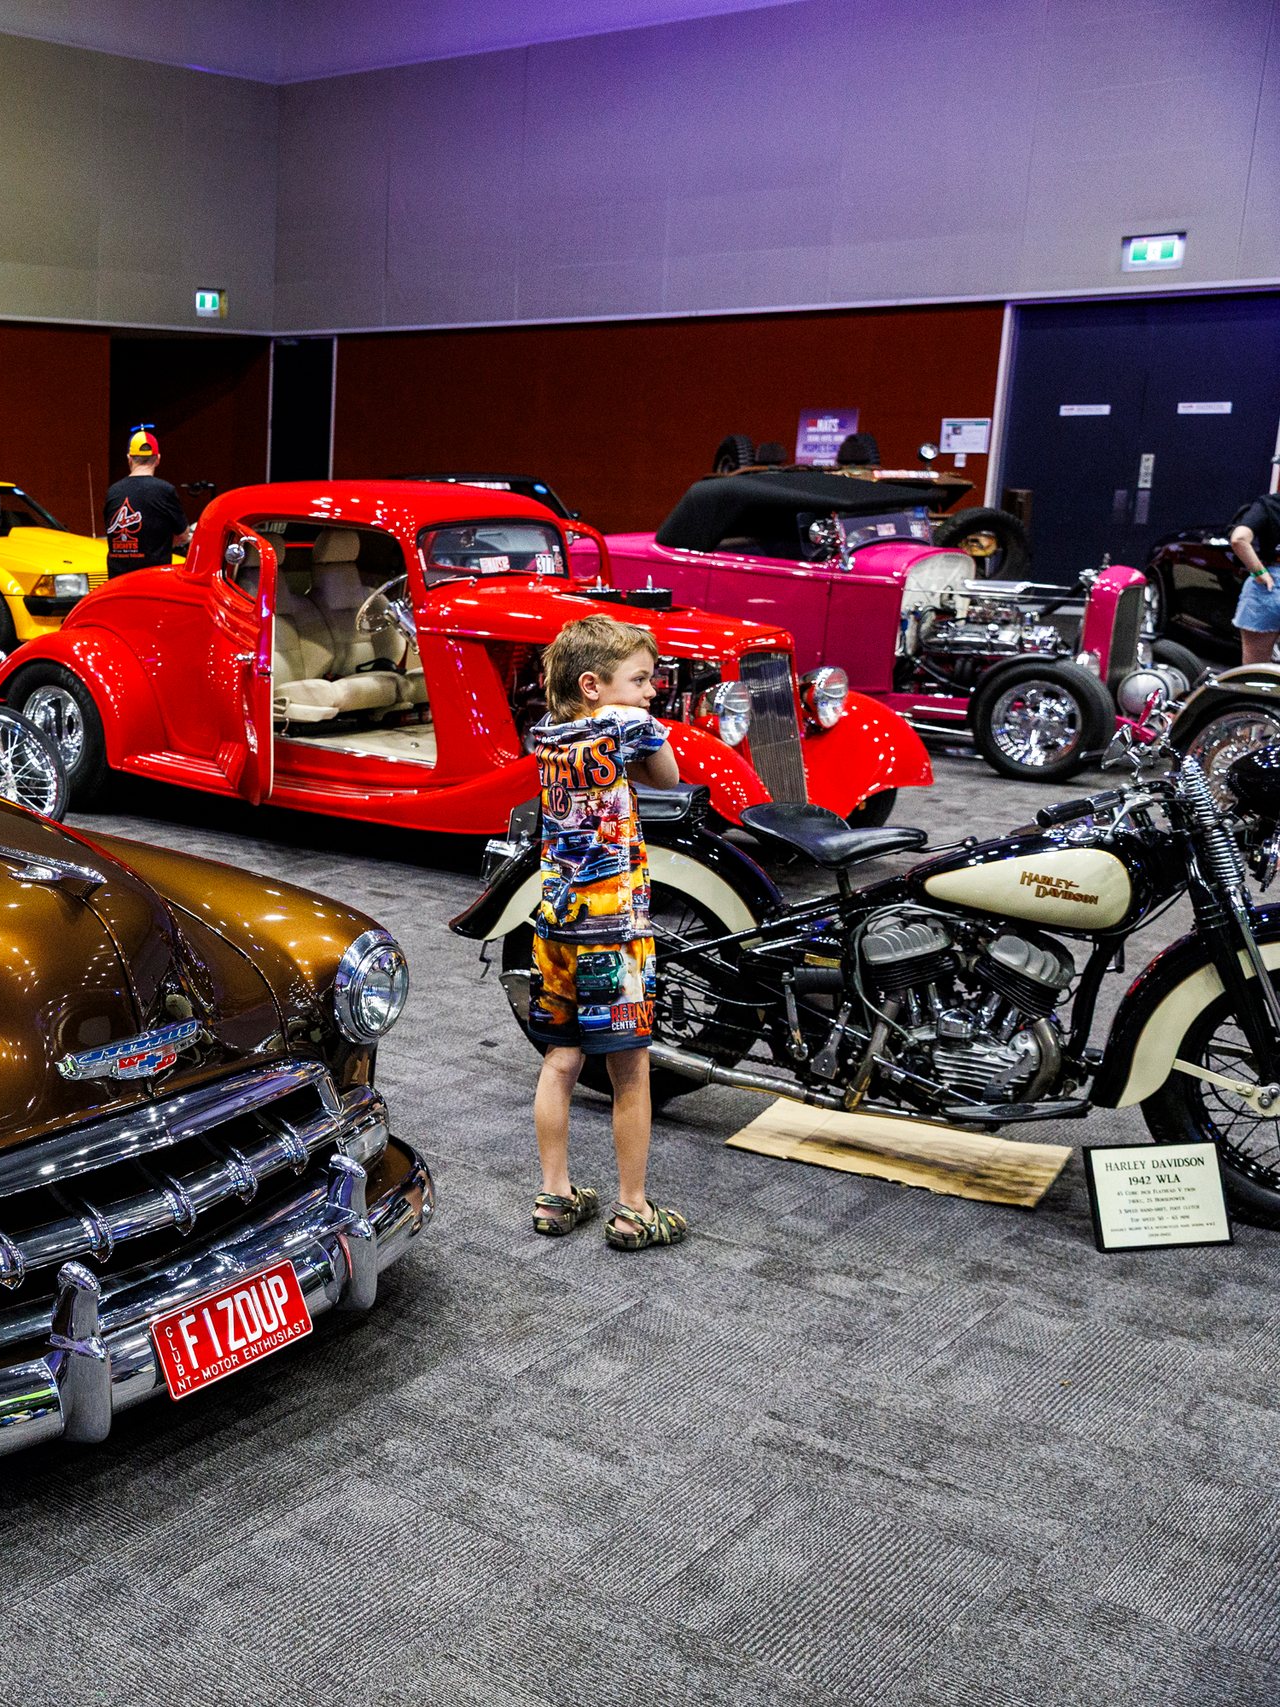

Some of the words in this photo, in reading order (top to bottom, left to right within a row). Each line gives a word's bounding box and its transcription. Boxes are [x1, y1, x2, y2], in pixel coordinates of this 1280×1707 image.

[552, 787, 565, 813] 12
[1034, 884, 1099, 905] DAVIDSON
[611, 1002, 637, 1023] RED
[611, 1020, 637, 1031] CENTRE
[1105, 1159, 1147, 1172] HARLEY
[1152, 1156, 1205, 1169] DAVIDSON
[1128, 1175, 1152, 1186] 1942
[1155, 1173, 1181, 1184] WLA
[201, 1354, 240, 1381] MOTOR
[243, 1319, 308, 1361] ENTHUSIAST
